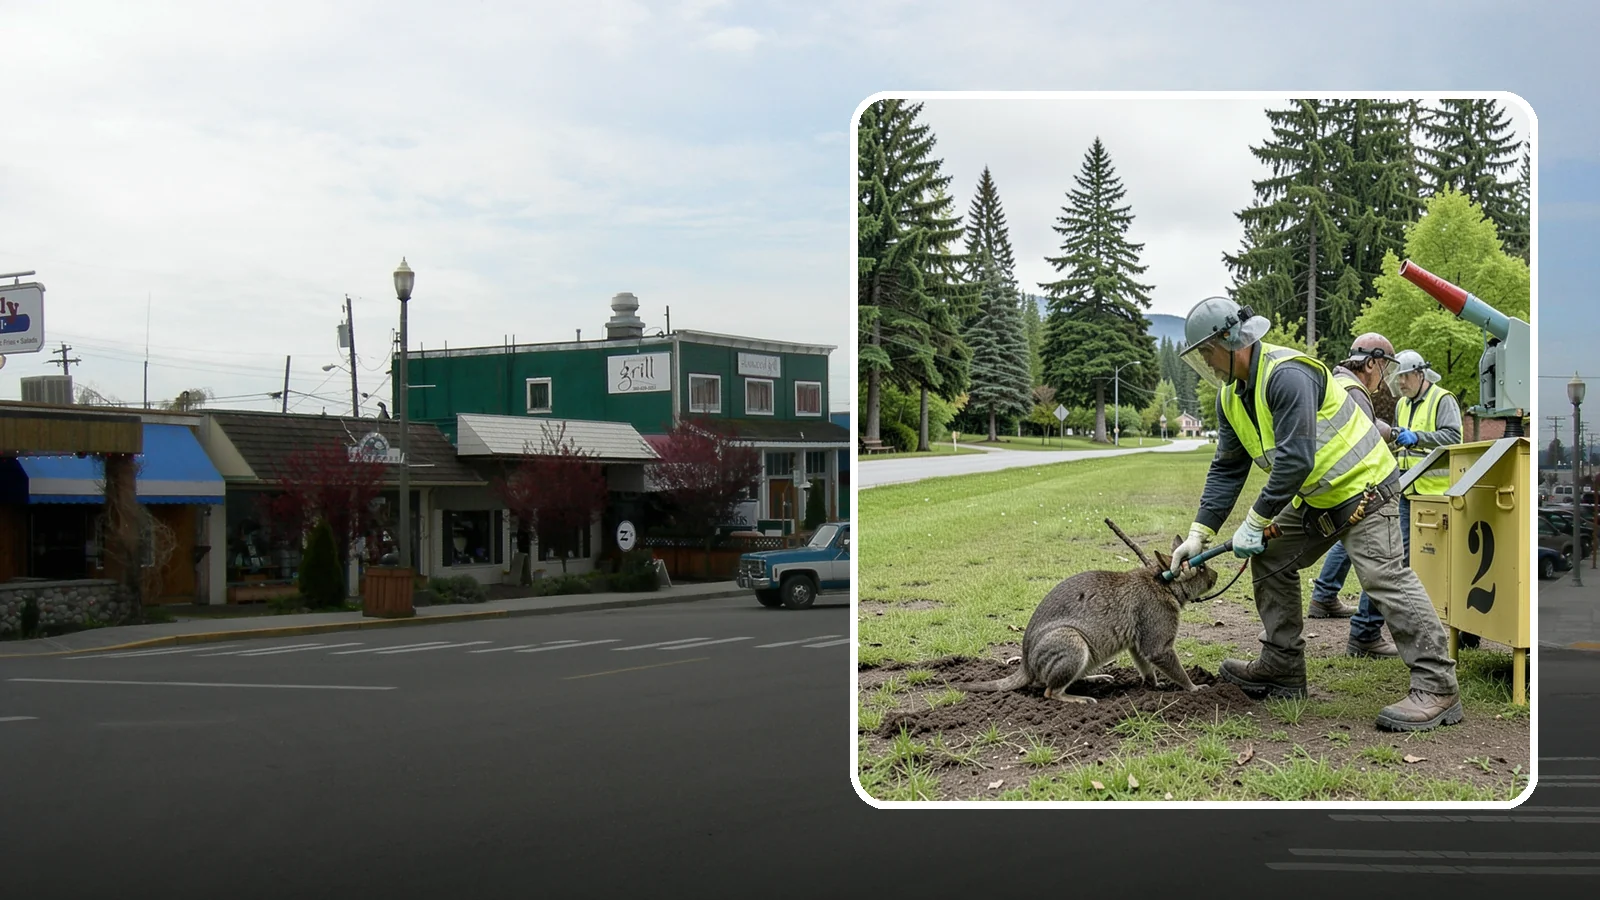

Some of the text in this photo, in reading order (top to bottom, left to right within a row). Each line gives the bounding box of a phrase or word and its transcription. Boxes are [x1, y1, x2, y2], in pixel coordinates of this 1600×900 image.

[20, 337, 38, 345] Salads
[617, 356, 654, 391] grill
[1467, 520, 1496, 614] 2
